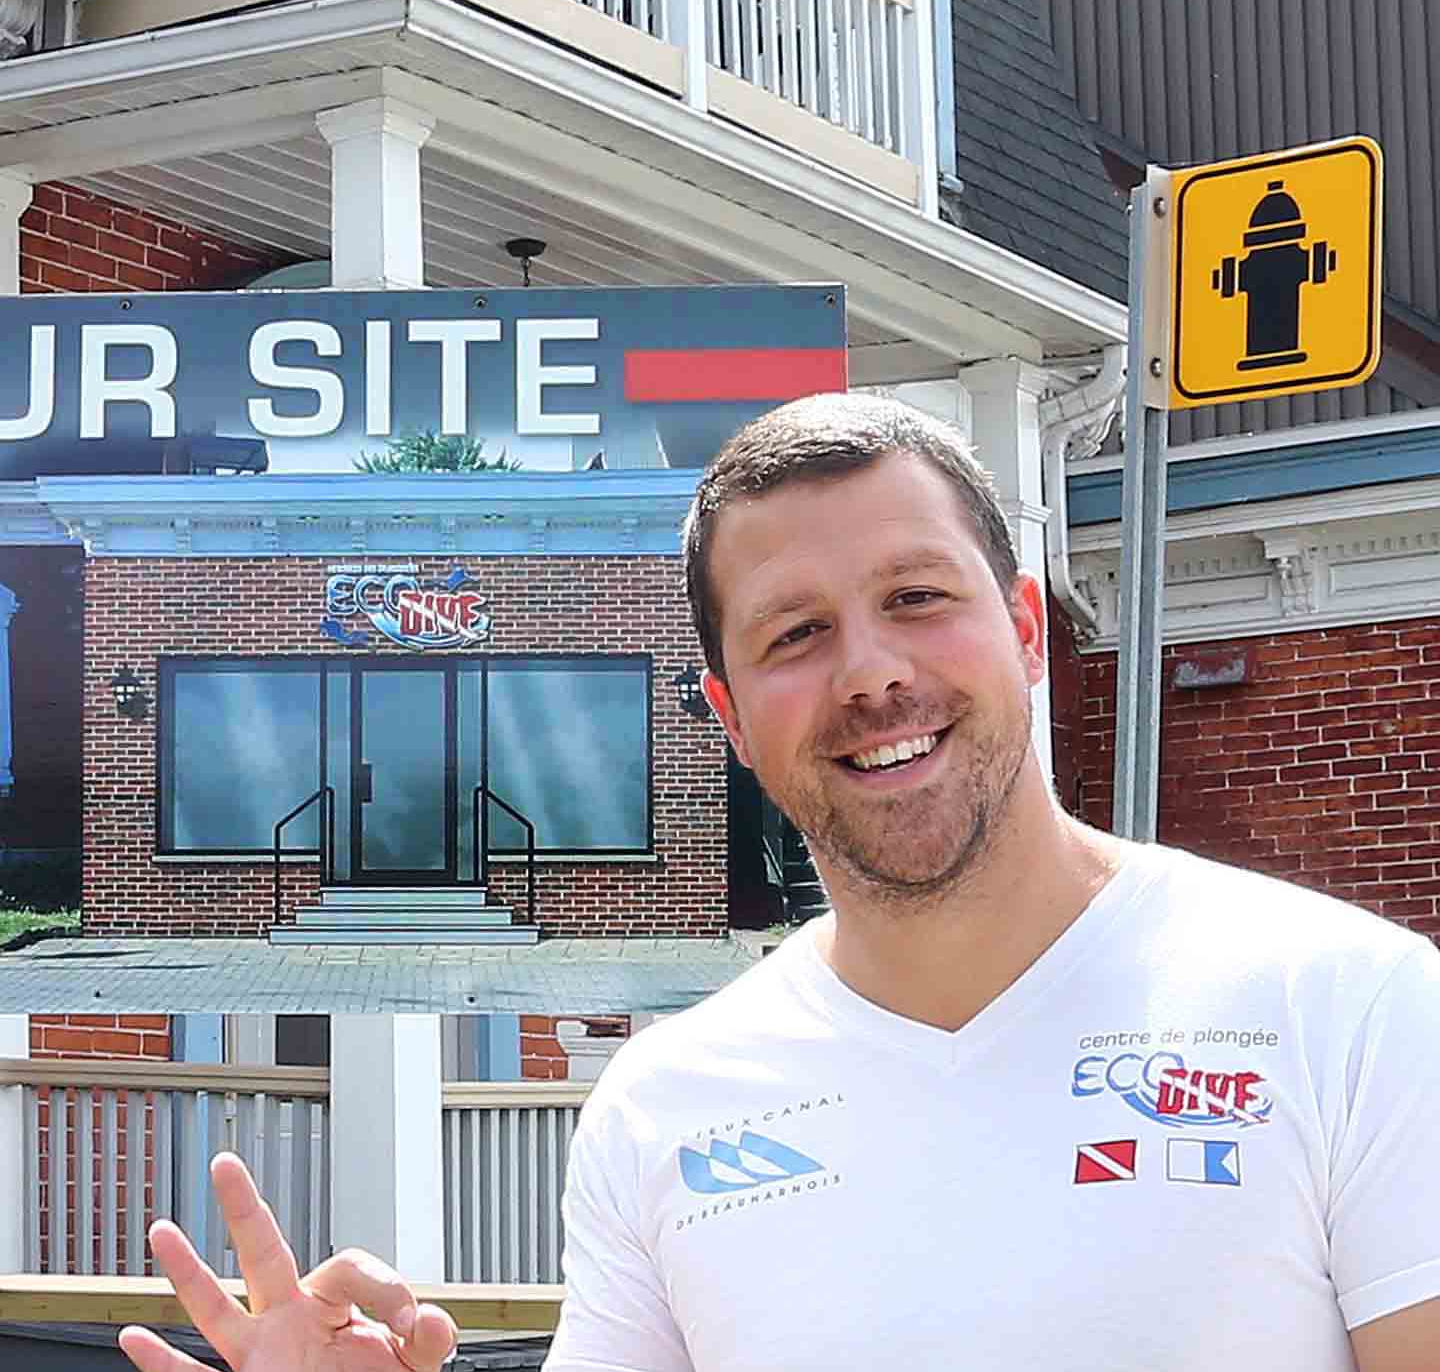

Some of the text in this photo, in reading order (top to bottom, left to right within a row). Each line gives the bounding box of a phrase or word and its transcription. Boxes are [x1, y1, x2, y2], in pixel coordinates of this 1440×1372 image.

[247, 317, 601, 437] SITE
[1079, 1026, 1279, 1050] centre de plongée
[762, 1093, 844, 1122] CANAL
